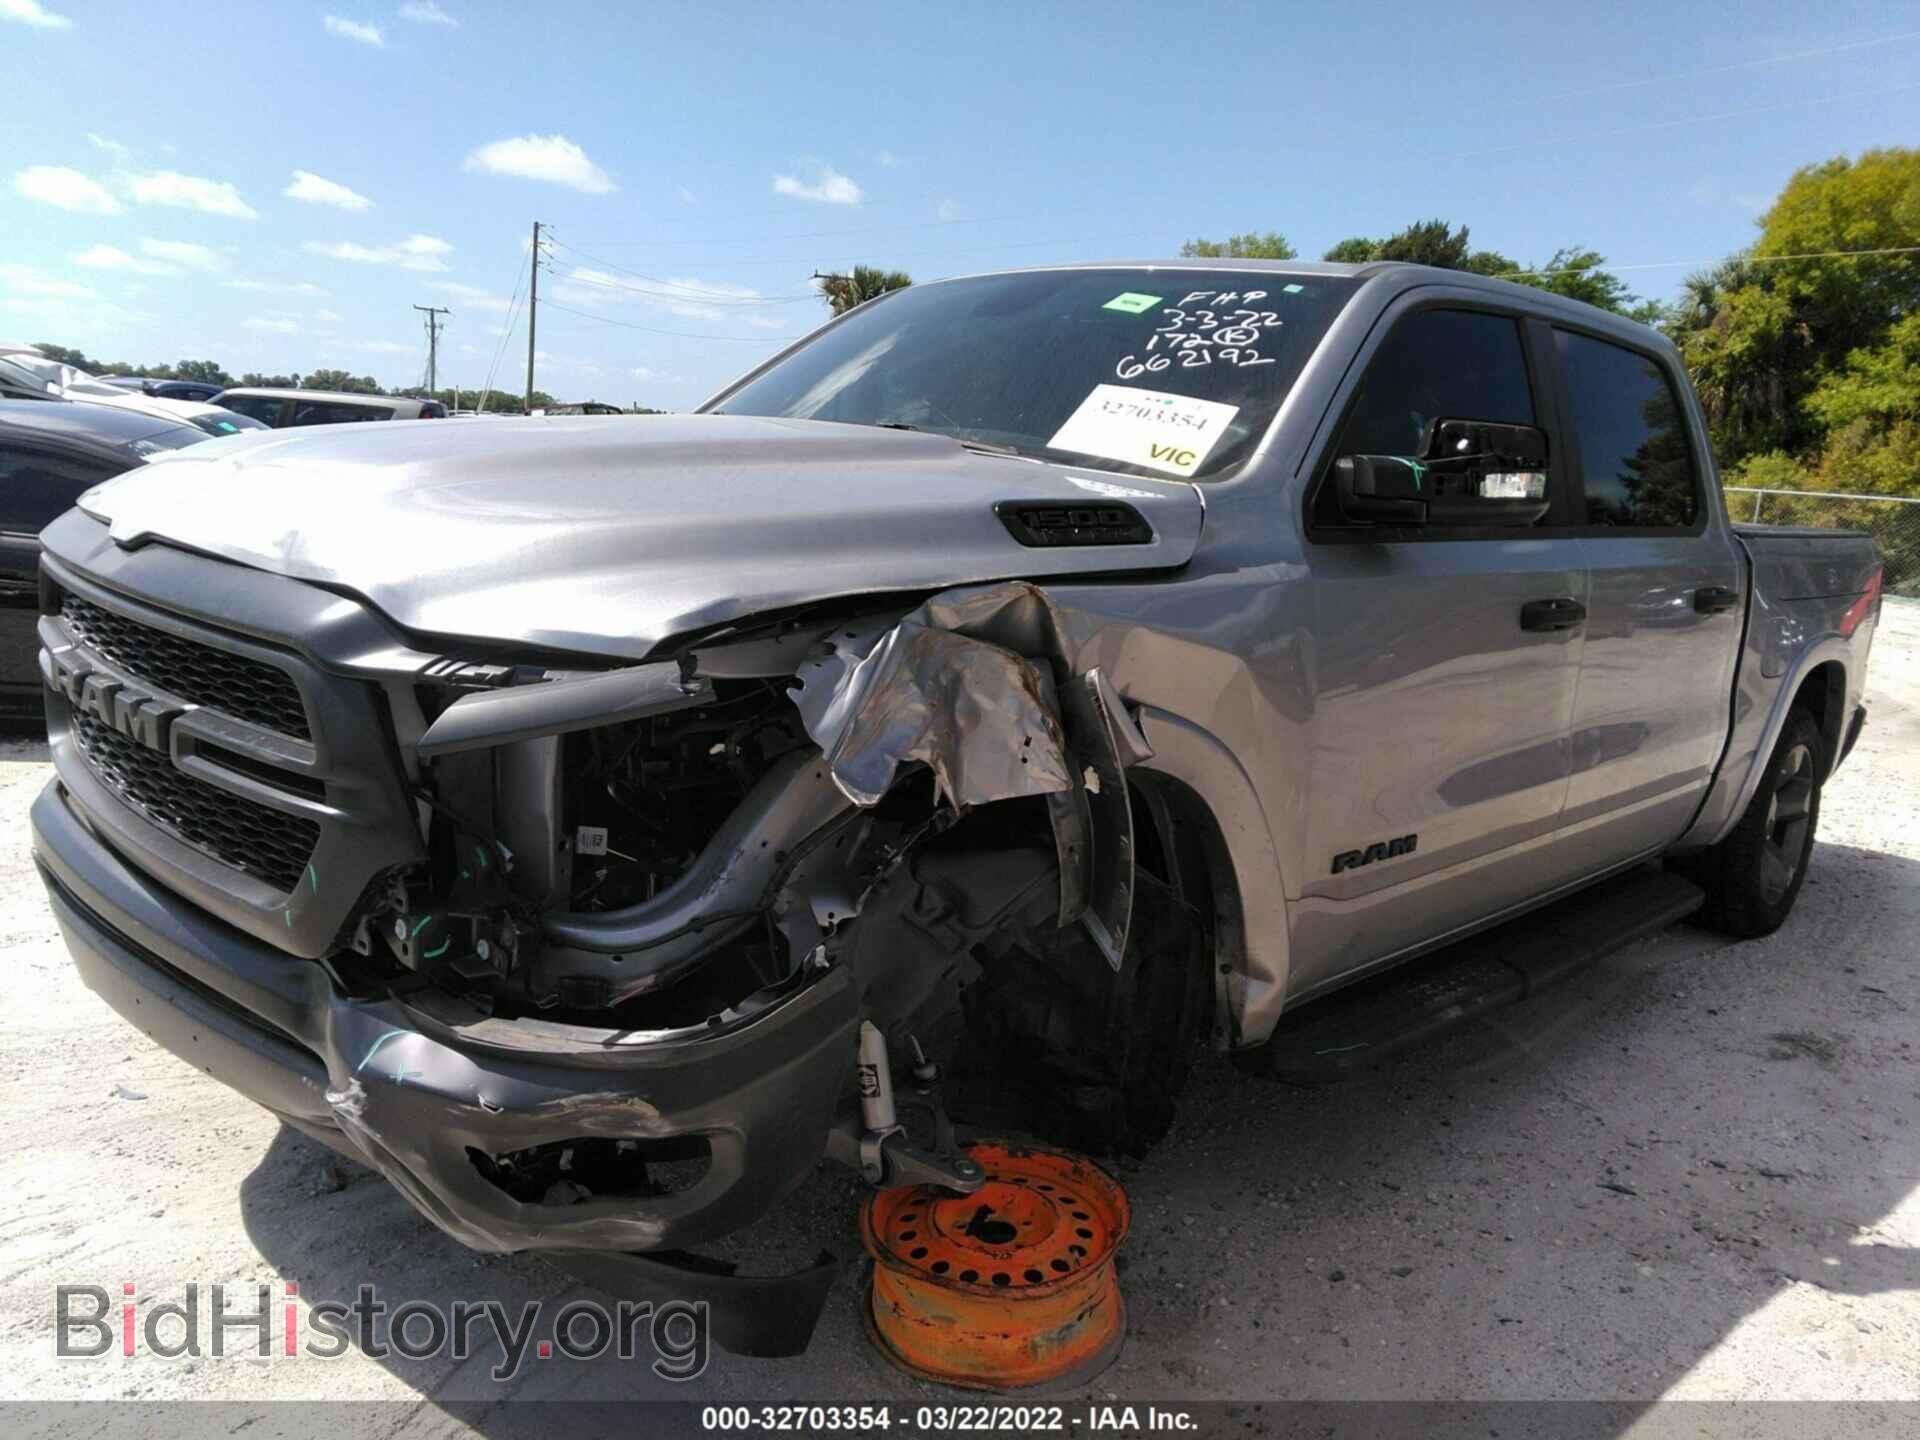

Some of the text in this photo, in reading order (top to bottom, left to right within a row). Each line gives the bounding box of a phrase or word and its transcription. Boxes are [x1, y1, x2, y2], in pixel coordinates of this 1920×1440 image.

[1177, 290, 1268, 306] FHP
[1156, 309, 1283, 331] 3-3-22
[1150, 443, 1197, 466] VIC
[1021, 508, 1126, 528] 1500
[51, 650, 173, 752] RAM
[1331, 833, 1418, 874] RAM
